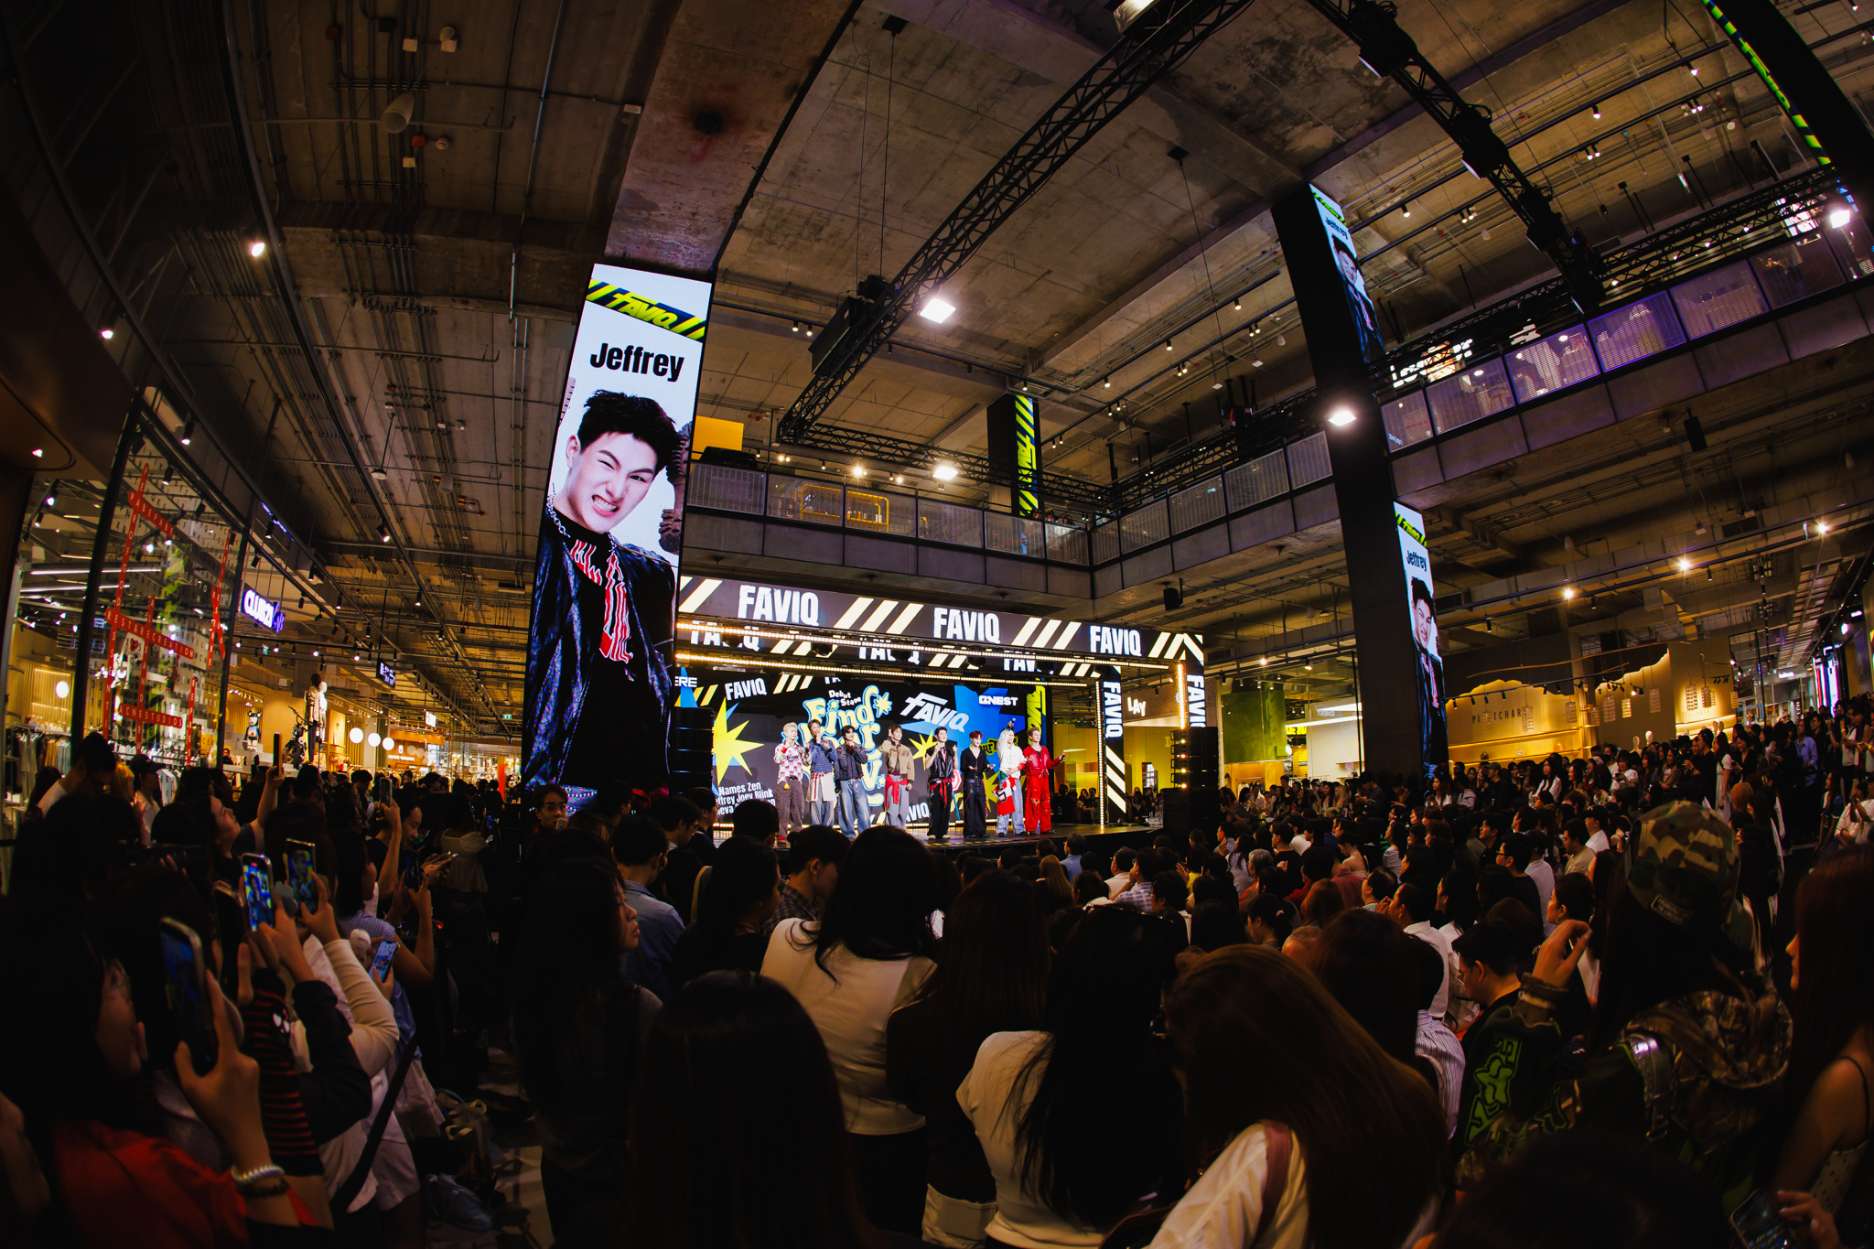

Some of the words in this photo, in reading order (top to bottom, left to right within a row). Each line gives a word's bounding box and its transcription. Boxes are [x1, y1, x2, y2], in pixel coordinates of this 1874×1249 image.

[590, 343, 685, 382] Jeffrey
[737, 584, 820, 627] FAVIQ
[933, 607, 1001, 645] FAVIQ
[1089, 625, 1142, 657] FAVIQ
[725, 678, 767, 701] FAVIQ
[900, 692, 969, 732] FAVIQ
[1103, 681, 1123, 739] FAVIQ
